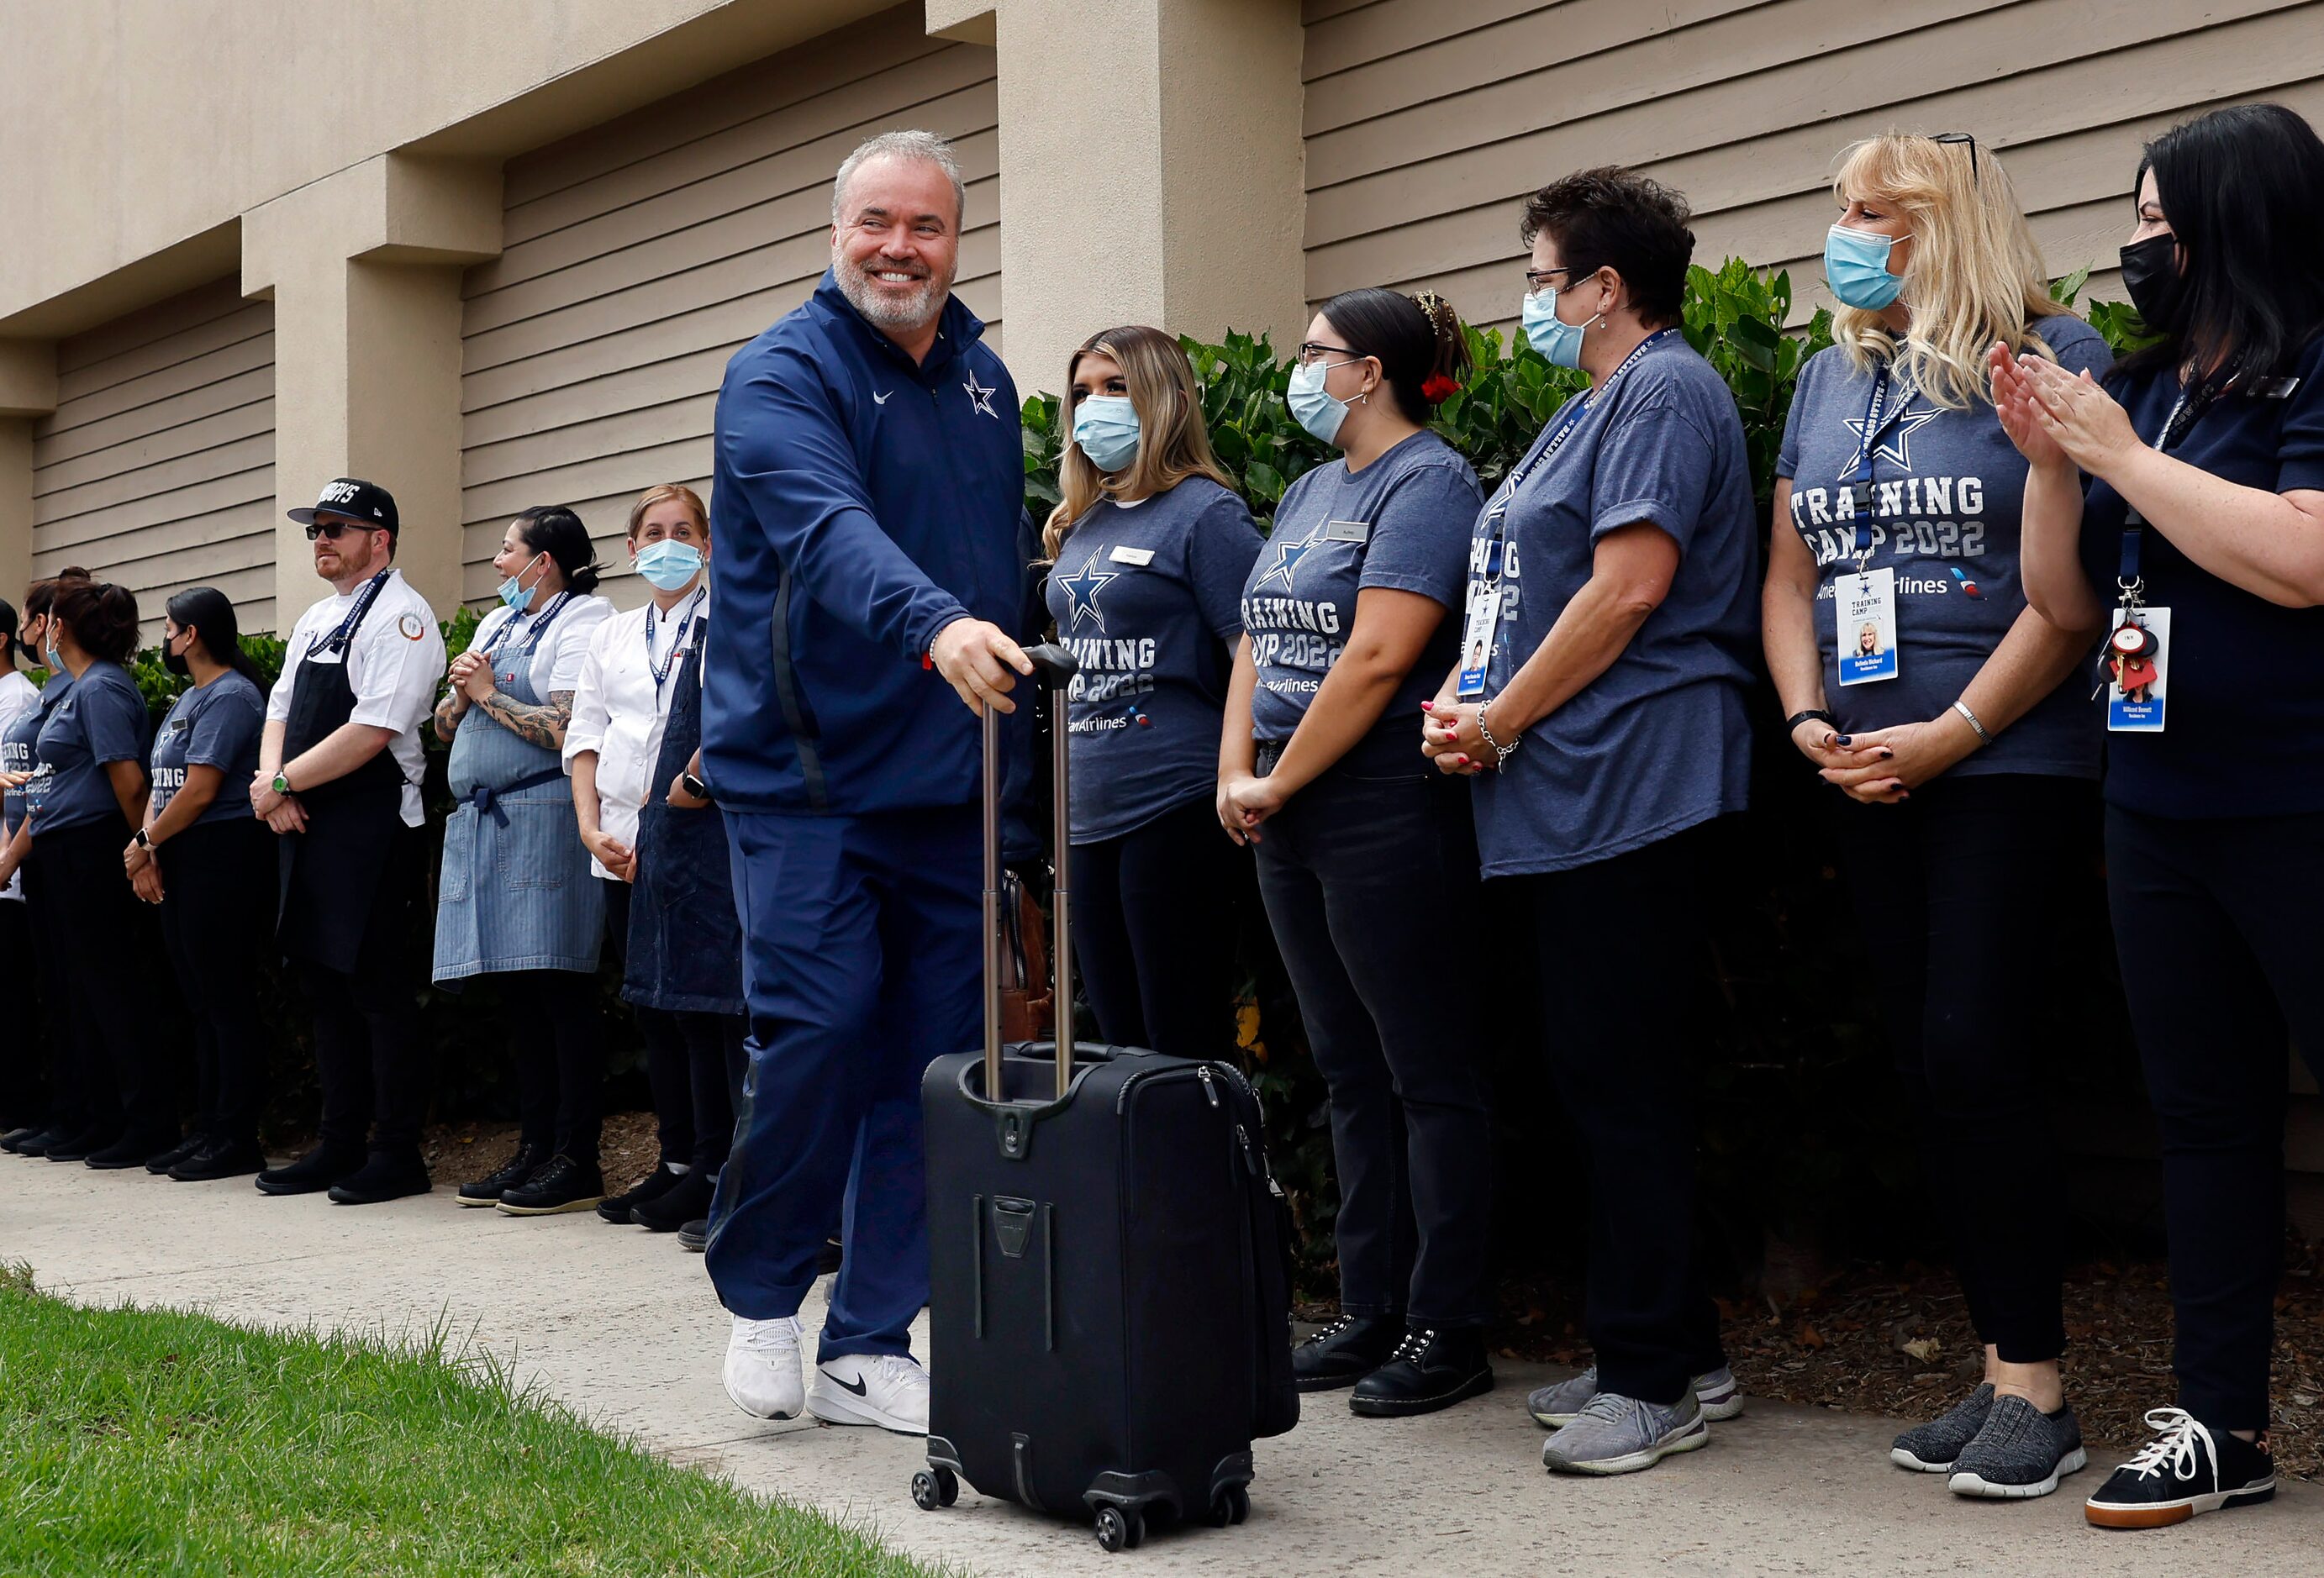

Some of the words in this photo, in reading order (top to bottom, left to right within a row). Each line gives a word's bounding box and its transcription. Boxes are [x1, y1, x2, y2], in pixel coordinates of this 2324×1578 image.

[1868, 386, 1885, 418] DALLAS
[1542, 424, 1571, 459] DALLAS
[1791, 476, 1984, 529] TRANING
[1892, 520, 1985, 558] 2022
[1852, 597, 1882, 609] TRAINING
[1852, 607, 1868, 617] CAMP
[1279, 634, 1346, 668] 2022
[1087, 673, 1155, 702] 2022
